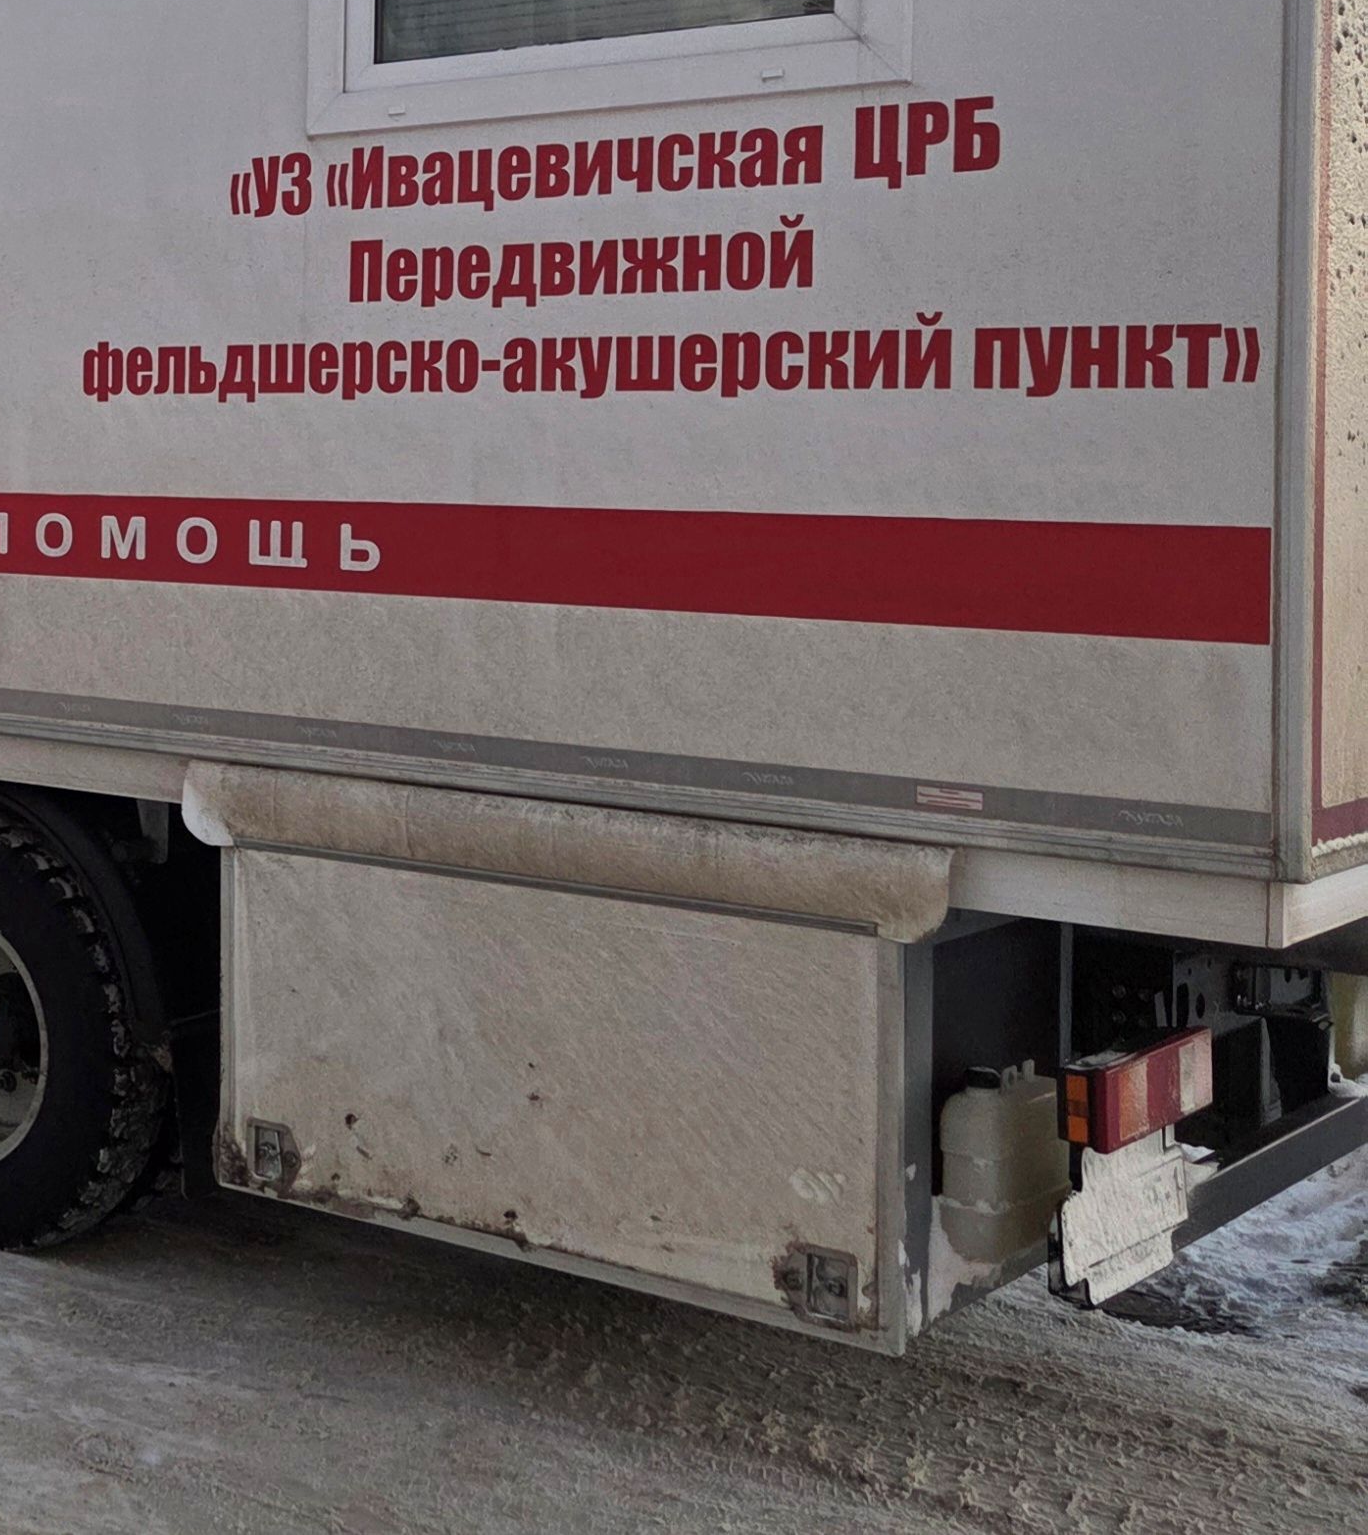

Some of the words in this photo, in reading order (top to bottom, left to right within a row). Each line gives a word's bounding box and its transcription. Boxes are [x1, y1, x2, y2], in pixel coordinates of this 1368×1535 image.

[231, 153, 312, 218] «УЗ
[327, 127, 822, 211] «Ивацевичская
[855, 97, 1001, 188] ЦРБ
[350, 214, 814, 307] Передвижной
[83, 311, 952, 402] фельдшерско-акушерский
[975, 323, 1259, 397] пункт»
